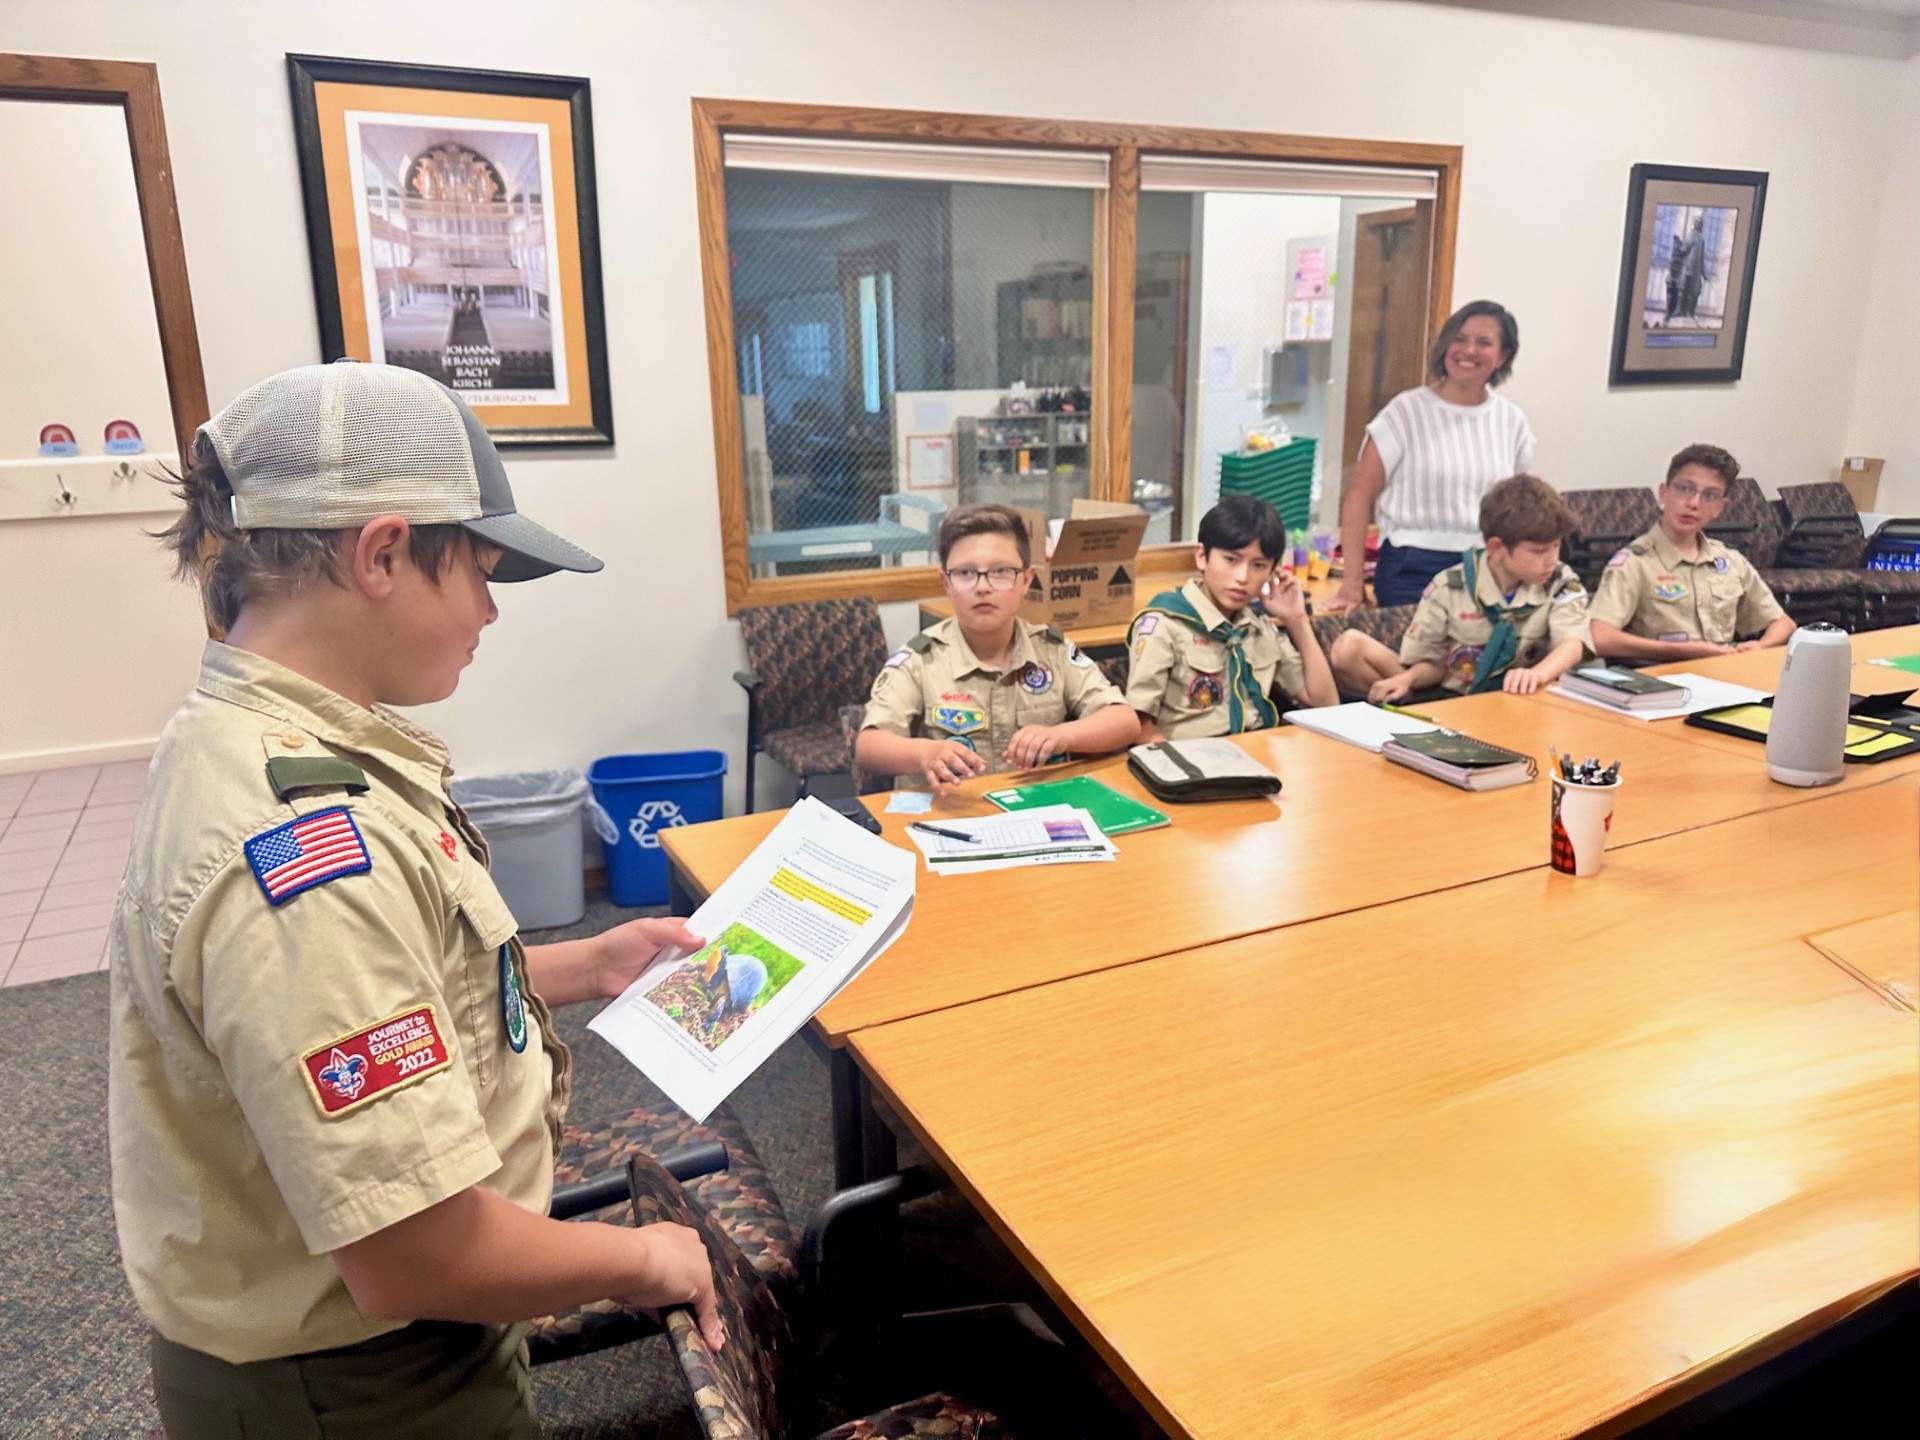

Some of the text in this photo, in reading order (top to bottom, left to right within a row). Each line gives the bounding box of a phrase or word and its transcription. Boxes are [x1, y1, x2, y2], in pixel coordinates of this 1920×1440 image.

[446, 345, 494, 355] JOHANN
[441, 356, 501, 366] SEBASTIAN
[455, 367, 489, 377] BACH
[452, 378, 493, 388] KIRCHE
[1050, 567, 1098, 584] POPPING
[1050, 584, 1081, 600] CORN
[367, 1015, 426, 1045] JOURNEY to
[368, 1024, 432, 1056] EXCELLENCE
[375, 1034, 435, 1065] GOLD AWARD
[395, 1047, 436, 1076] 2022
